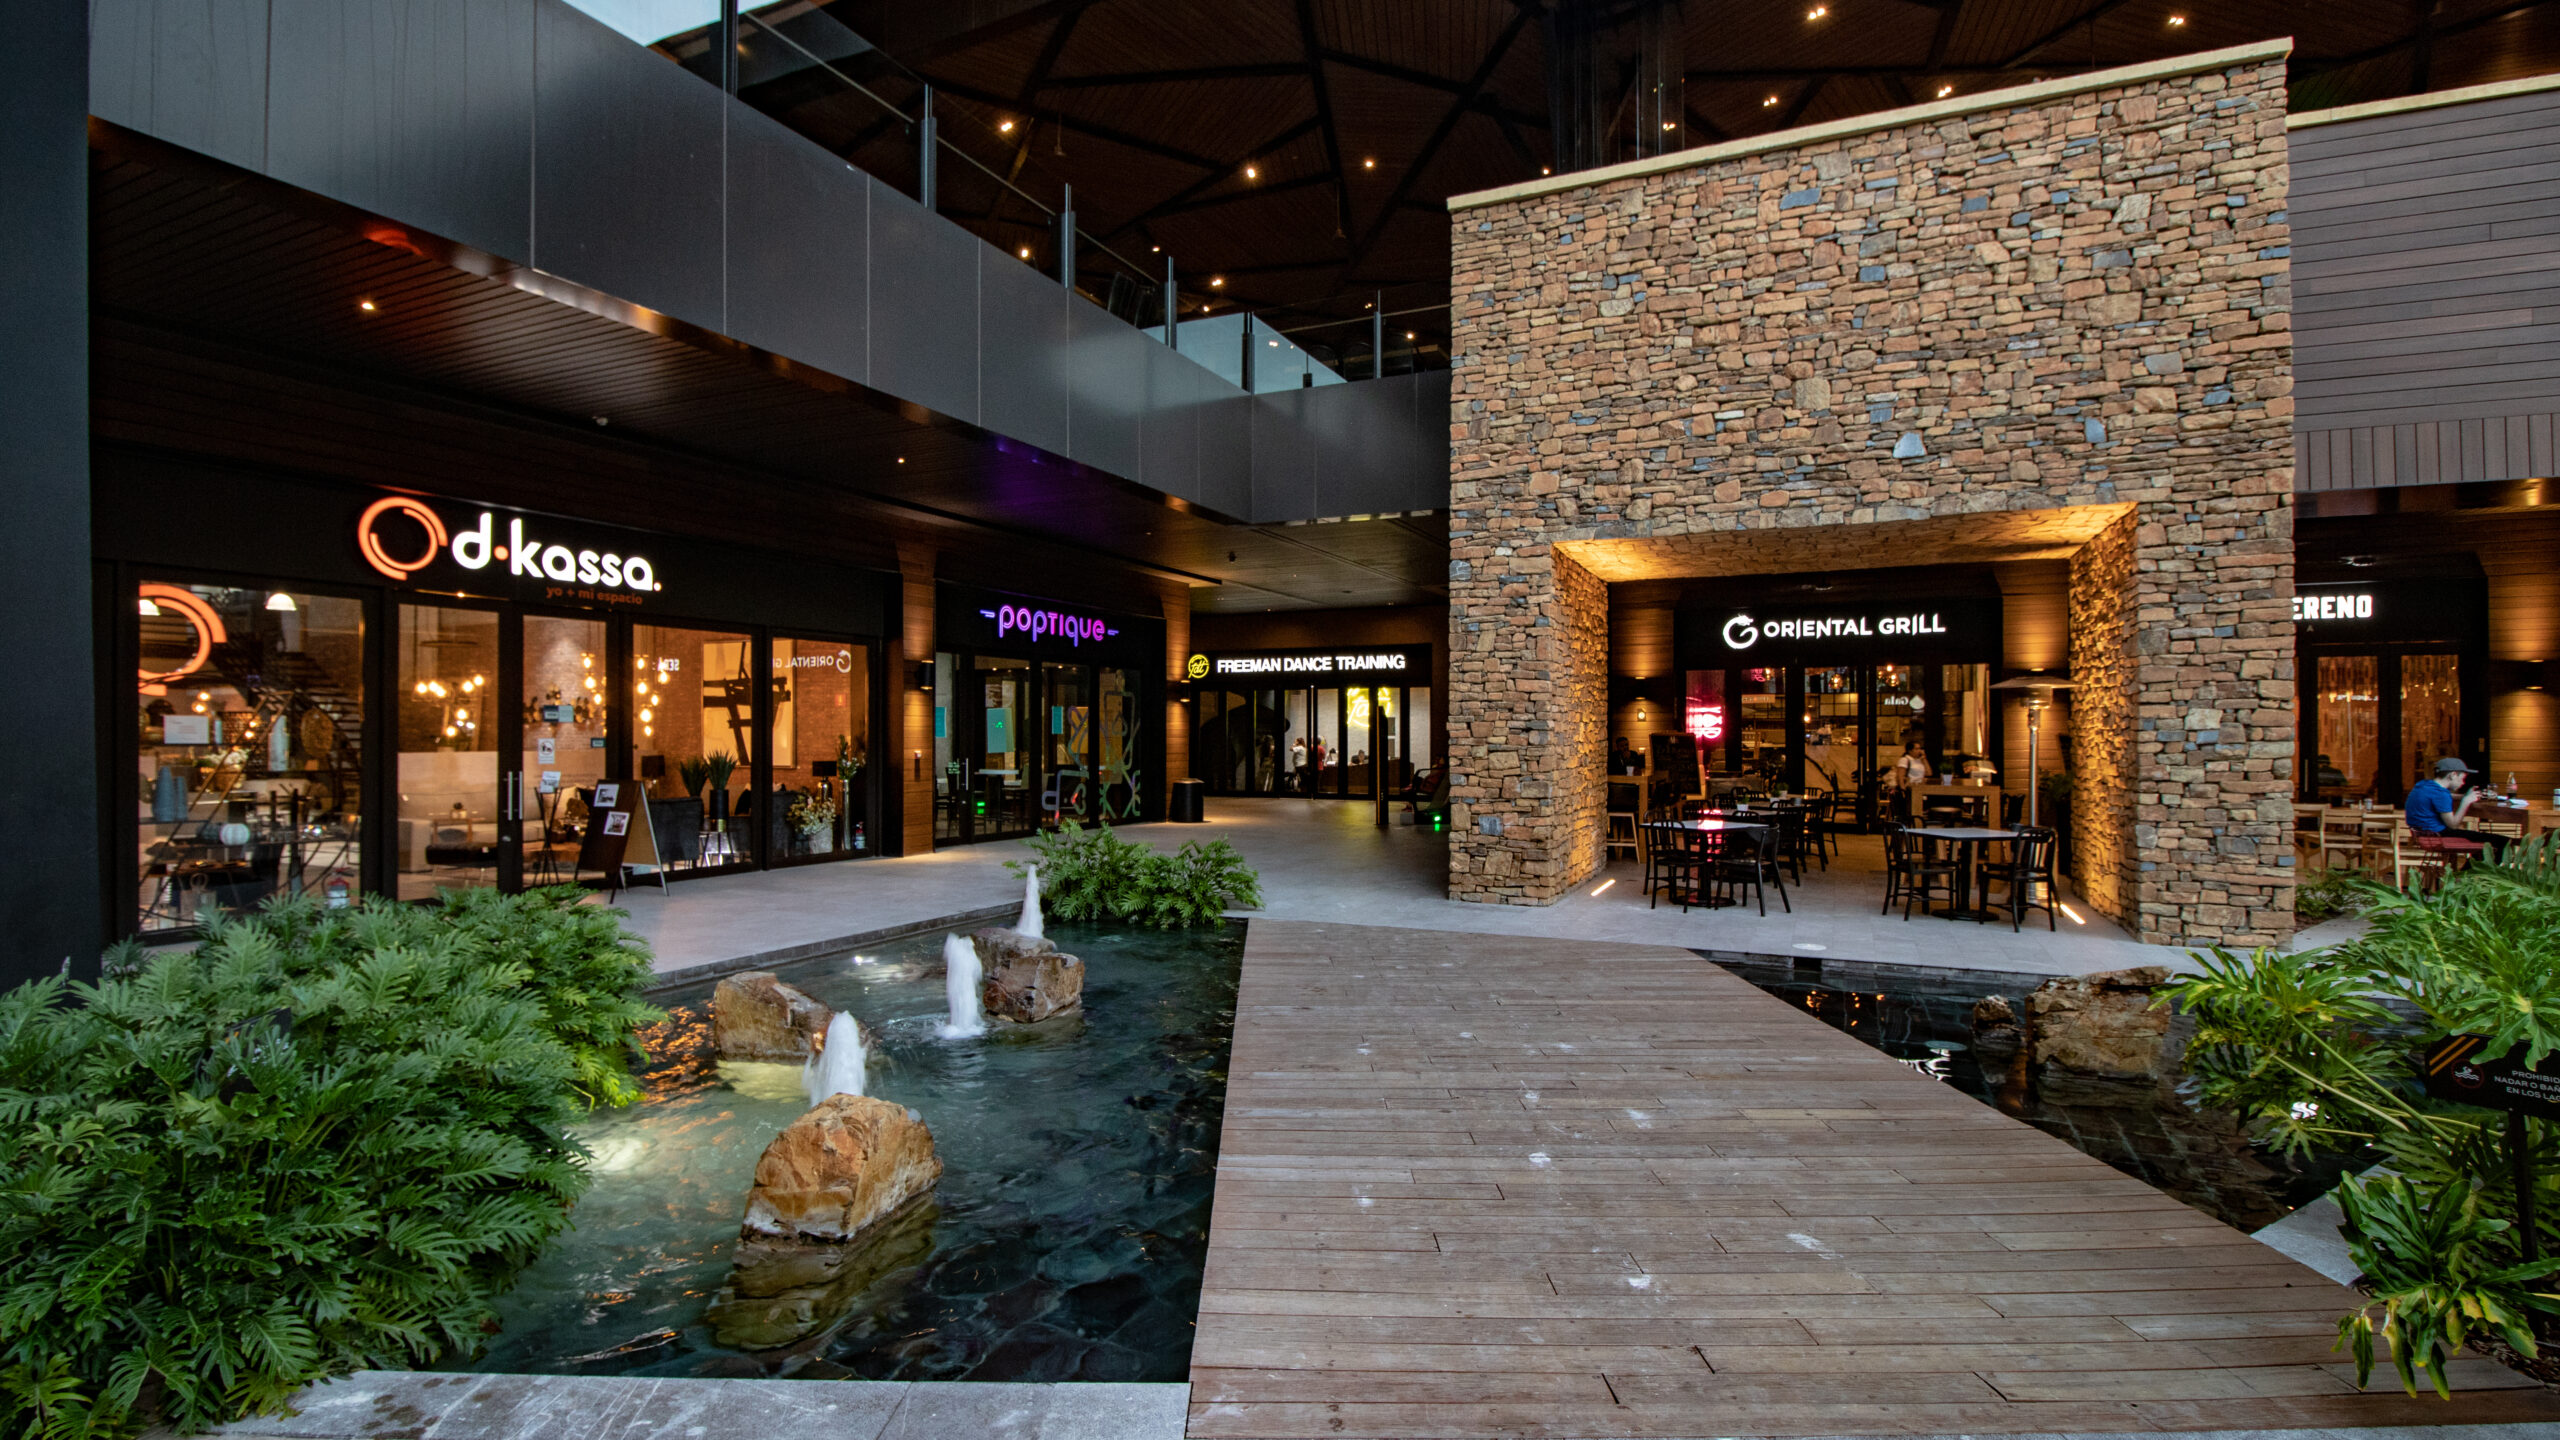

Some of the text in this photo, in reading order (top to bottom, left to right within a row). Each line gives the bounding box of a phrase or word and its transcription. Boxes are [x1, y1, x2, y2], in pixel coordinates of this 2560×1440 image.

[546, 586, 563, 598] yo
[578, 588, 594, 599] mi
[597, 590, 643, 605] espacio
[1763, 617, 1873, 640] ORIENTAL
[1878, 613, 1946, 636] GRILL
[1217, 657, 1281, 673] FREEMAN
[1284, 656, 1332, 672] DANCE
[1336, 654, 1405, 671] TRAINING
[2494, 1076, 2528, 1087] NADAR
[2529, 1081, 2538, 1089] O
[2522, 1090, 2541, 1098] LOS
